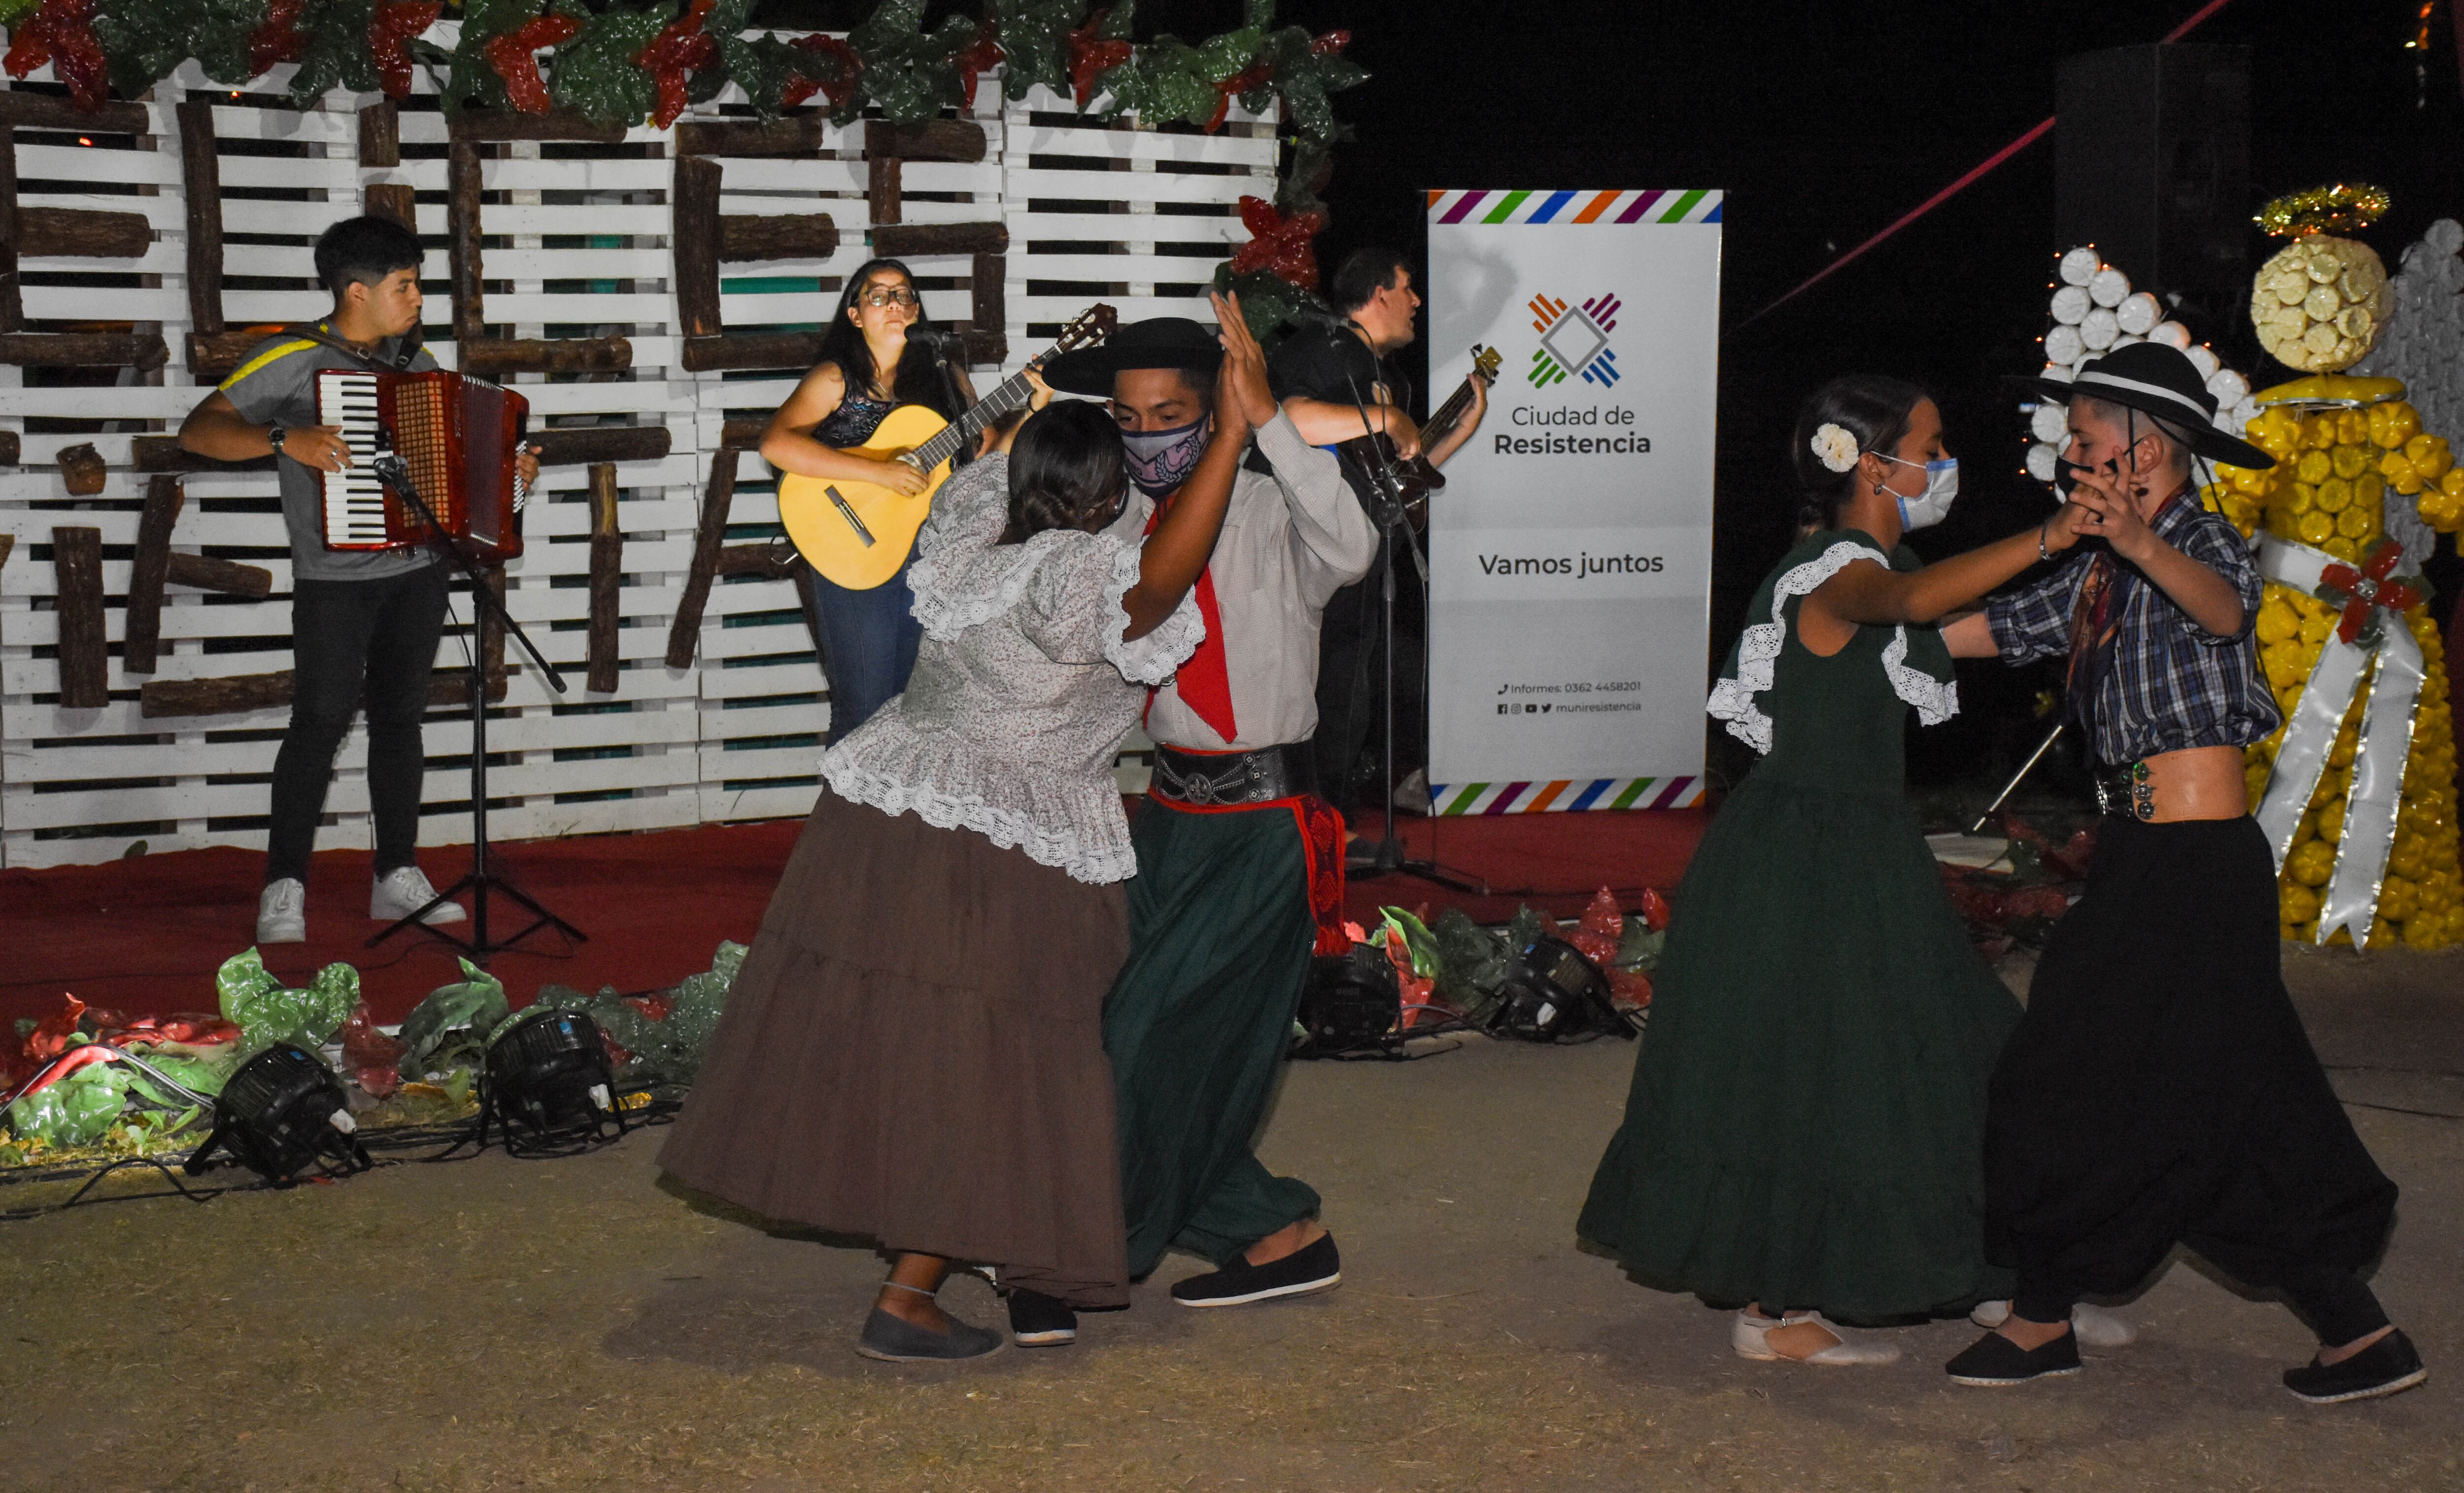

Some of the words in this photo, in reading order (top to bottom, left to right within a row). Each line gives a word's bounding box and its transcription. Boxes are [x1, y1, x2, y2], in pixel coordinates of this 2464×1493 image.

[1512, 405, 1597, 426] Ciudad
[1605, 405, 1635, 425] de
[1495, 431, 1651, 454] Resistencia
[1478, 554, 1572, 575] Vamos
[1577, 552, 1664, 579] juntos
[1511, 684, 1562, 694] Informes:
[1565, 683, 1592, 693] 0362
[1595, 681, 1641, 692] 4458201
[1556, 702, 1642, 713] muniresistencia
